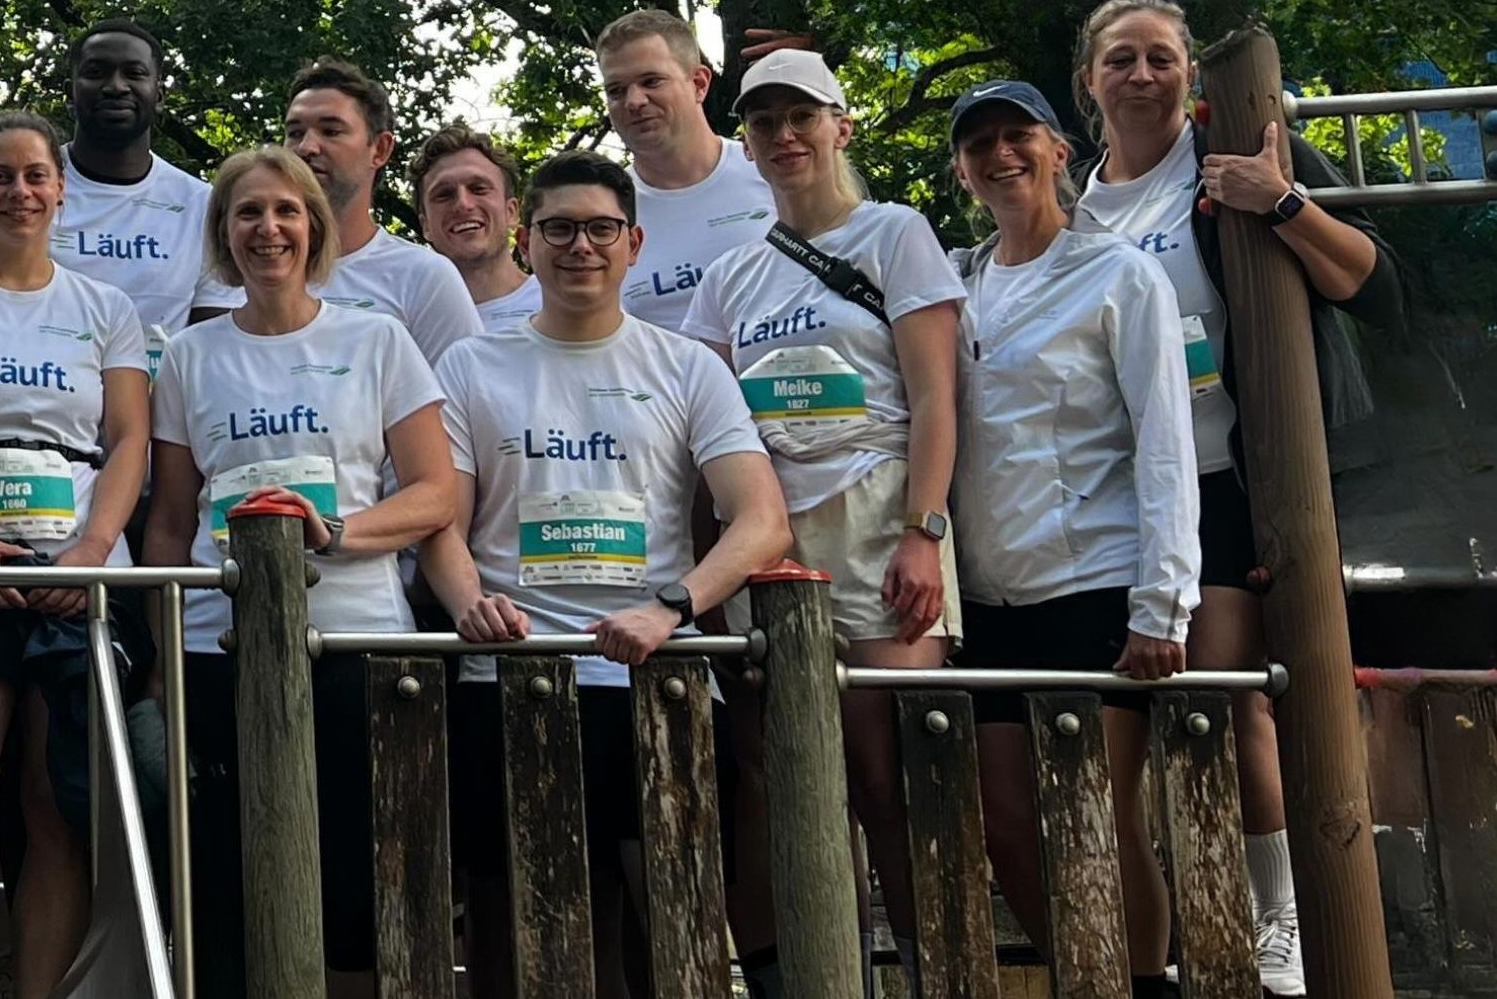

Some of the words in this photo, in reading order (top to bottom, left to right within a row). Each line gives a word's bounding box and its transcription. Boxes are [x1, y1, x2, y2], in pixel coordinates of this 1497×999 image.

[78, 231, 169, 260] Läuft.
[738, 306, 826, 349] Läuft.
[773, 378, 823, 397] Meike
[229, 404, 329, 441] Läuft.
[524, 428, 627, 461] Läuft.
[541, 523, 626, 541] Sebastian
